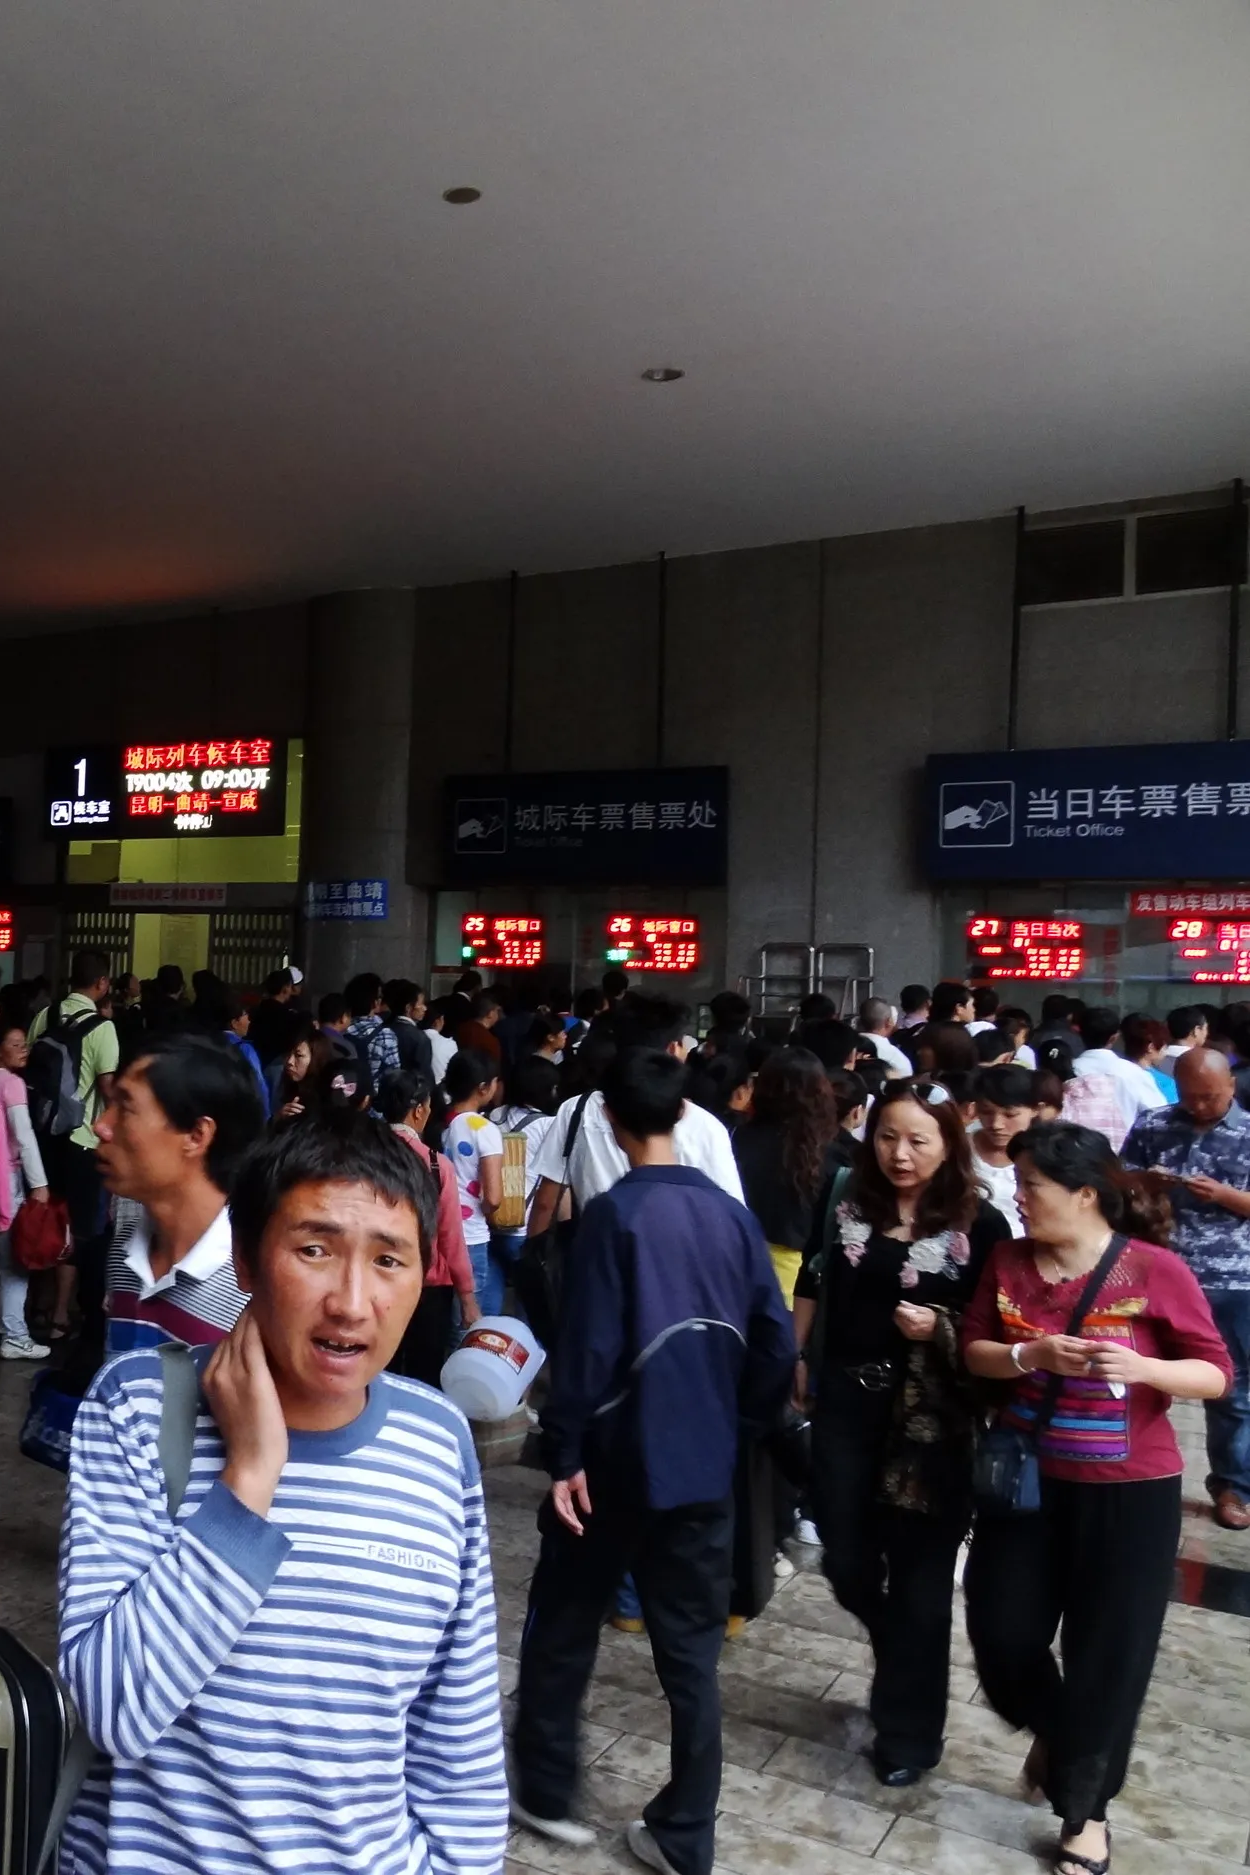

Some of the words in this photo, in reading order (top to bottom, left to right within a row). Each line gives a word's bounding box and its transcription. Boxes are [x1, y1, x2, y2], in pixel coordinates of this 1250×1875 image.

[126, 740, 271, 769] 城际列车候车室
[74, 758, 87, 797] 1
[126, 771, 194, 793] T9004次
[201, 768, 270, 790] 09:00开
[73, 800, 111, 816] 候车室
[1027, 782, 1250, 820] 当日车票售票
[514, 800, 717, 832] 城际车票售票处
[1023, 824, 1071, 838] Ticket
[1076, 823, 1125, 837] Office
[465, 917, 485, 931] 25
[610, 918, 632, 932] 26
[971, 920, 999, 936] 27
[1013, 922, 1081, 937] 当日当次
[1172, 921, 1203, 937] 28
[367, 1545, 437, 1569] FASHION
